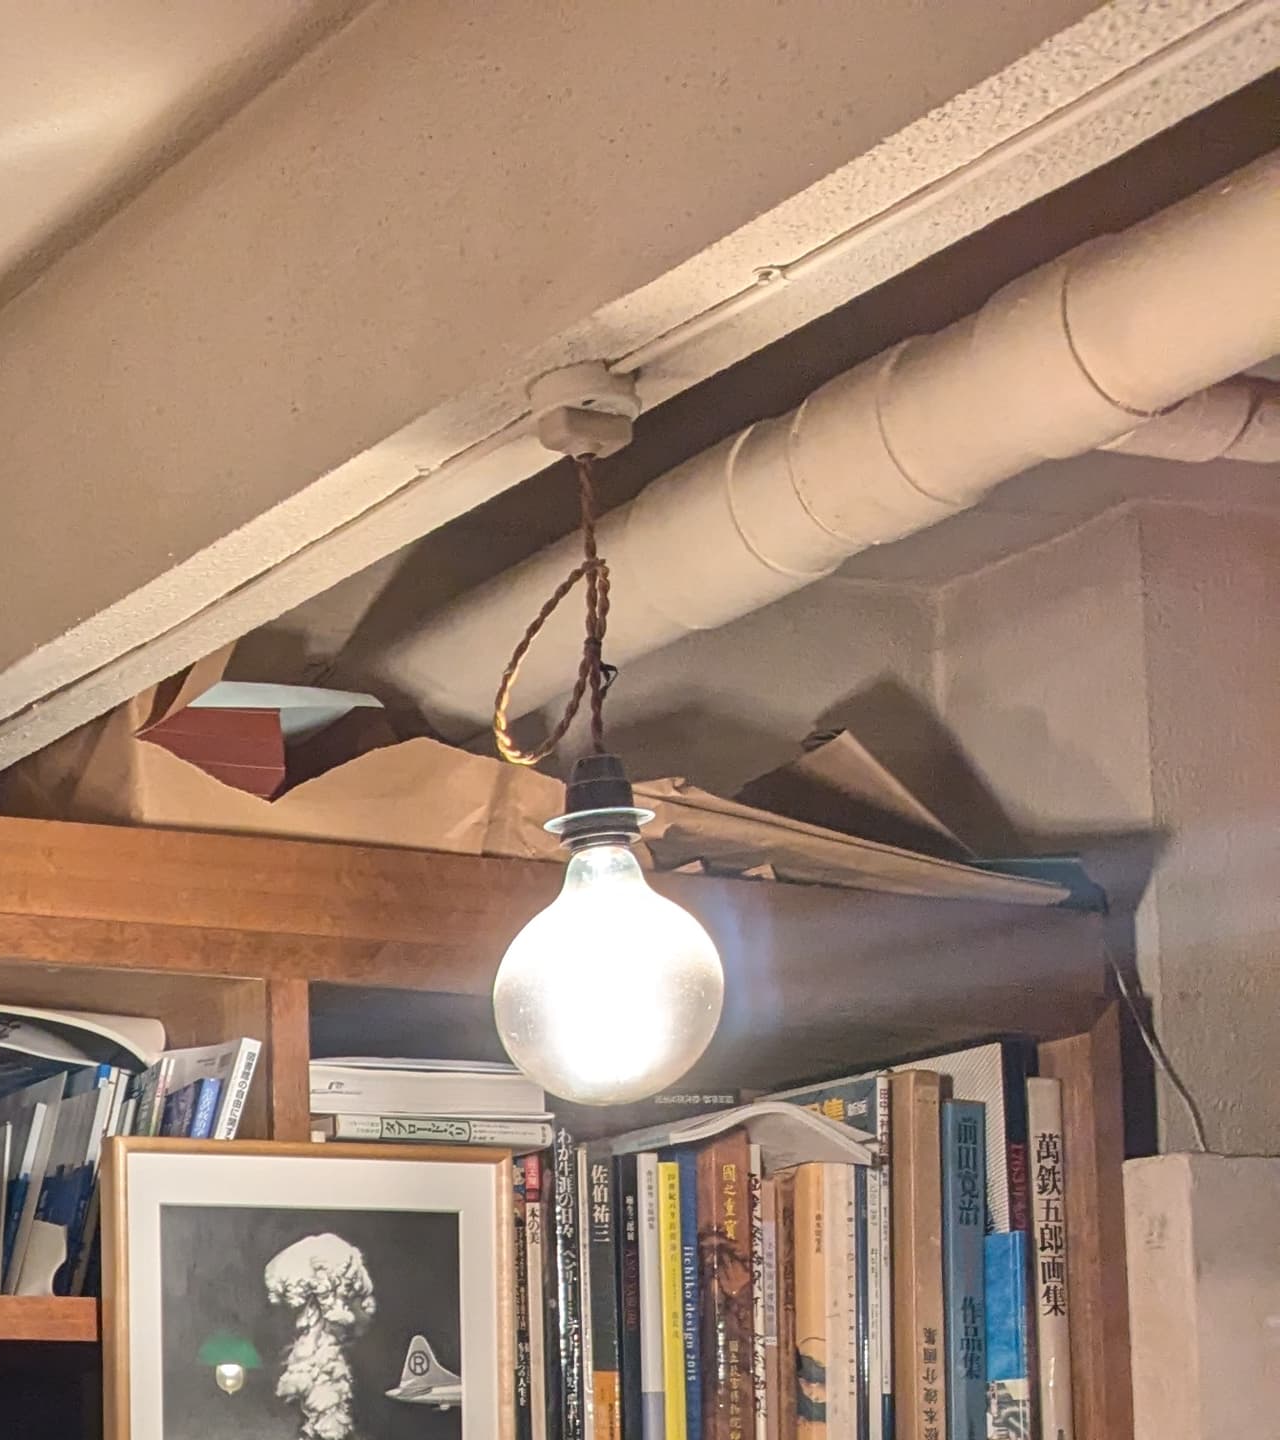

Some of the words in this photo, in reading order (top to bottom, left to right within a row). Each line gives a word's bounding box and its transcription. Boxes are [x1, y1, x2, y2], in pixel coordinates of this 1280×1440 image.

[557, 1127, 574, 1238] わが生涯の日々
[590, 1163, 611, 1243] 佐伯祐三
[956, 1117, 979, 1226] 前田寛治
[1034, 1132, 1066, 1317] 萬鉄五郎画集
[684, 1302, 696, 1349] design
[686, 1353, 697, 1382] 2015
[959, 1296, 982, 1380] 作品集
